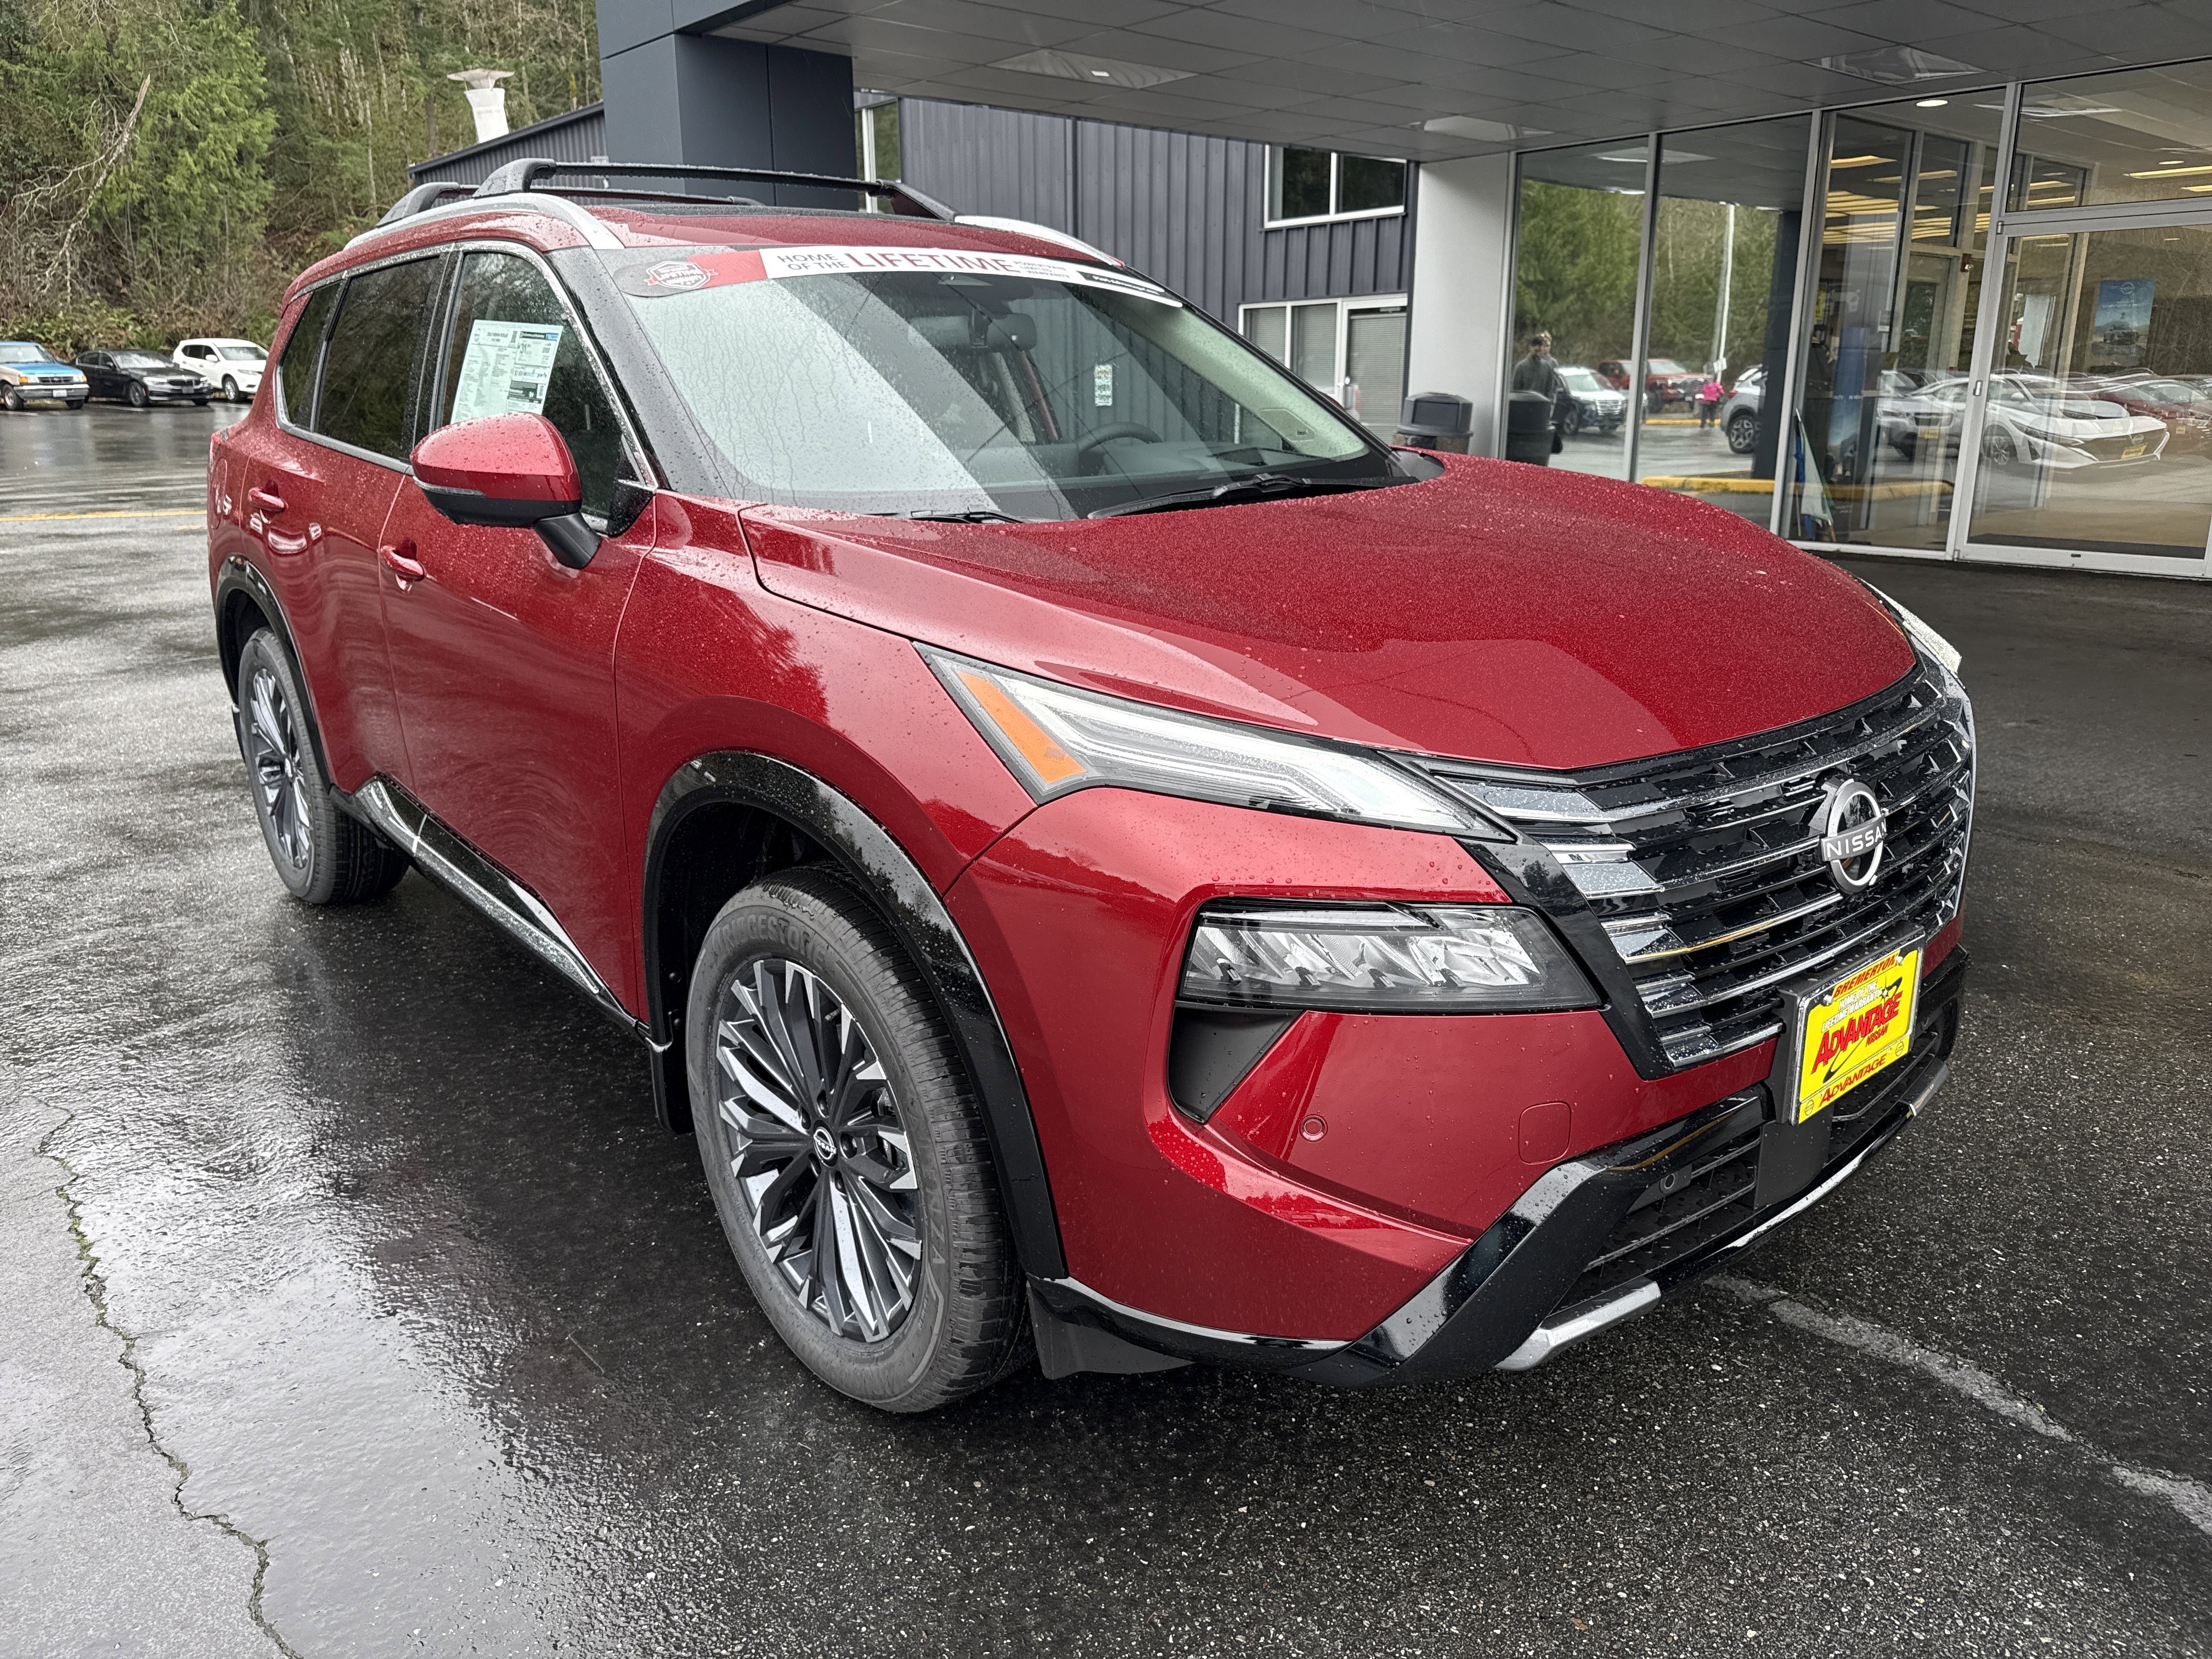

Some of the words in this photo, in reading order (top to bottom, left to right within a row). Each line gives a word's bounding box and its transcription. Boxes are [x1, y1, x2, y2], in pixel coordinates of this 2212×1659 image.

[777, 253, 839, 263] HOME
[812, 261, 850, 269] THE
[845, 253, 1021, 273] LIFETIME
[1826, 818, 1887, 858] NISSAN
[710, 913, 827, 972] BRIDGESTONE
[1833, 953, 1898, 998] BREMERTON
[1839, 994, 1857, 1010] HOME
[1856, 986, 1866, 1000] OF
[1866, 981, 1877, 995] THE
[1822, 1008, 1849, 1032] LIFETIME
[1849, 988, 1883, 1015] WARRANTY
[1811, 991, 1903, 1075] ADVANTAGE
[1866, 1024, 1889, 1046] NISSAN
[1818, 1054, 1887, 1108] ADVANTAGE
